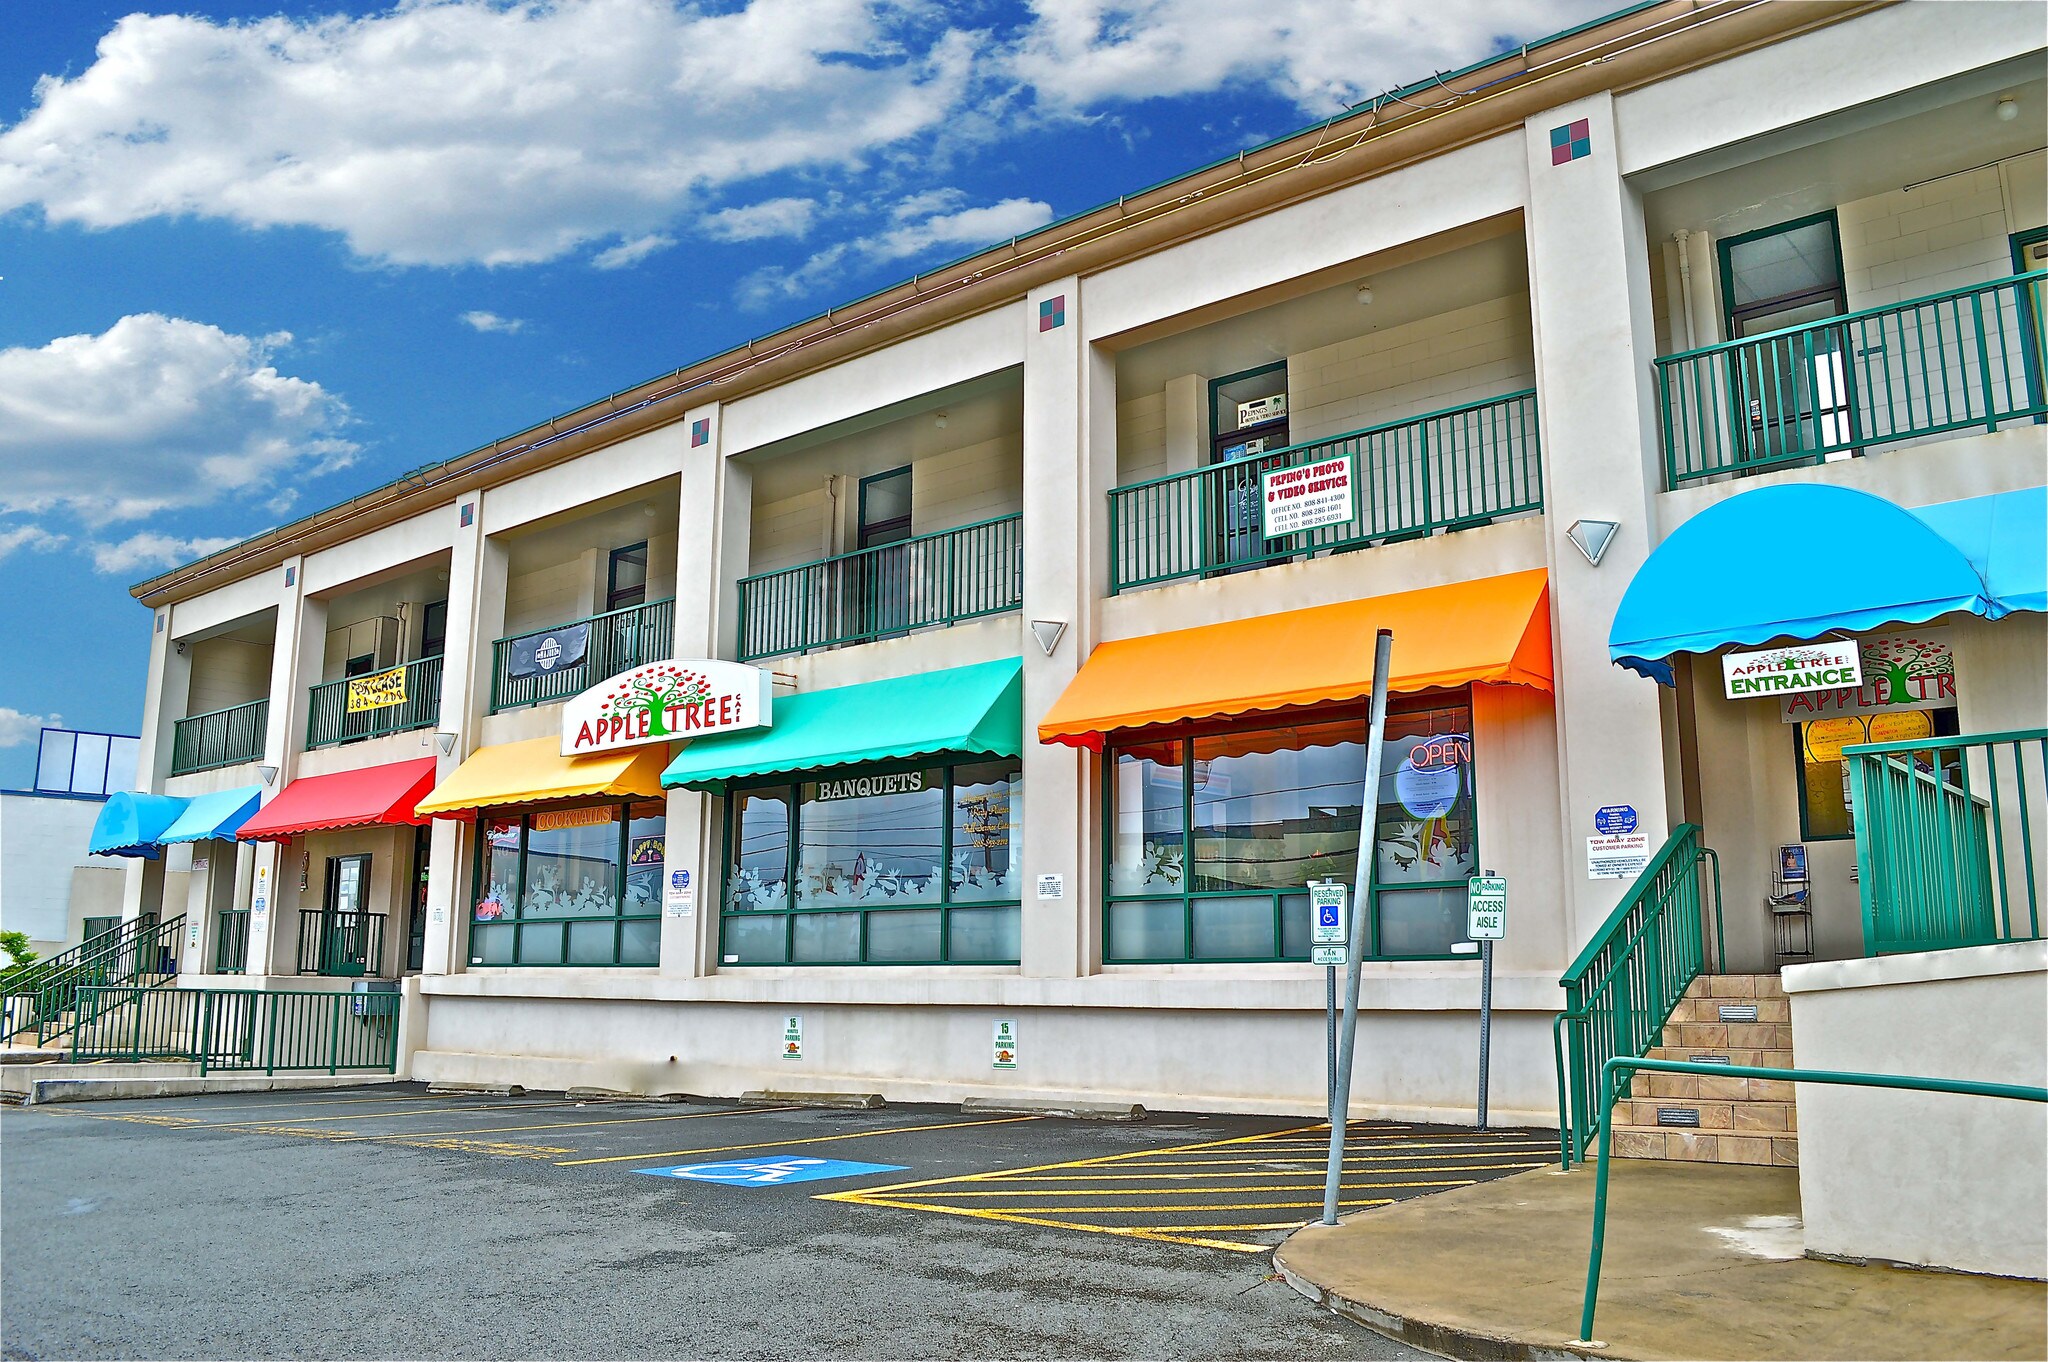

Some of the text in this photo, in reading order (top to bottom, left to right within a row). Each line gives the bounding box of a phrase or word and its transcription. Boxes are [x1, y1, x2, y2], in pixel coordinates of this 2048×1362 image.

[1270, 461, 1345, 487] PEPING'S PHOTO
[1268, 475, 1348, 502] & VIDEO SERVICE
[1271, 504, 1291, 515] OFFICE
[1292, 502, 1302, 511] NO.
[1274, 514, 1288, 523] CELL
[1289, 512, 1300, 521] NO.
[1274, 523, 1288, 532] CELL
[1289, 521, 1300, 530] NO.
[1733, 663, 1785, 676] APPLE
[1799, 656, 1843, 669] TREE
[370, 670, 403, 694] LEASE
[1731, 667, 1856, 694] ENTRANCE
[1787, 679, 1890, 714] APPLE
[734, 693, 742, 723] CAFE
[574, 694, 733, 748] APPLE TREE
[1410, 742, 1471, 767] OPEN
[819, 771, 922, 800] BANQUETS
[538, 807, 611, 829] COCKTAILS
[1314, 889, 1344, 898] RESERVED
[1470, 881, 1505, 894] NO PARKING
[1316, 897, 1341, 906] PARKING
[1471, 900, 1503, 912] ACCESS
[1476, 916, 1498, 928] AISLE
[790, 1017, 797, 1028] 15
[1001, 1022, 1009, 1034] 15
[785, 1034, 800, 1042] PARKING
[995, 1041, 1015, 1049] PARKING
